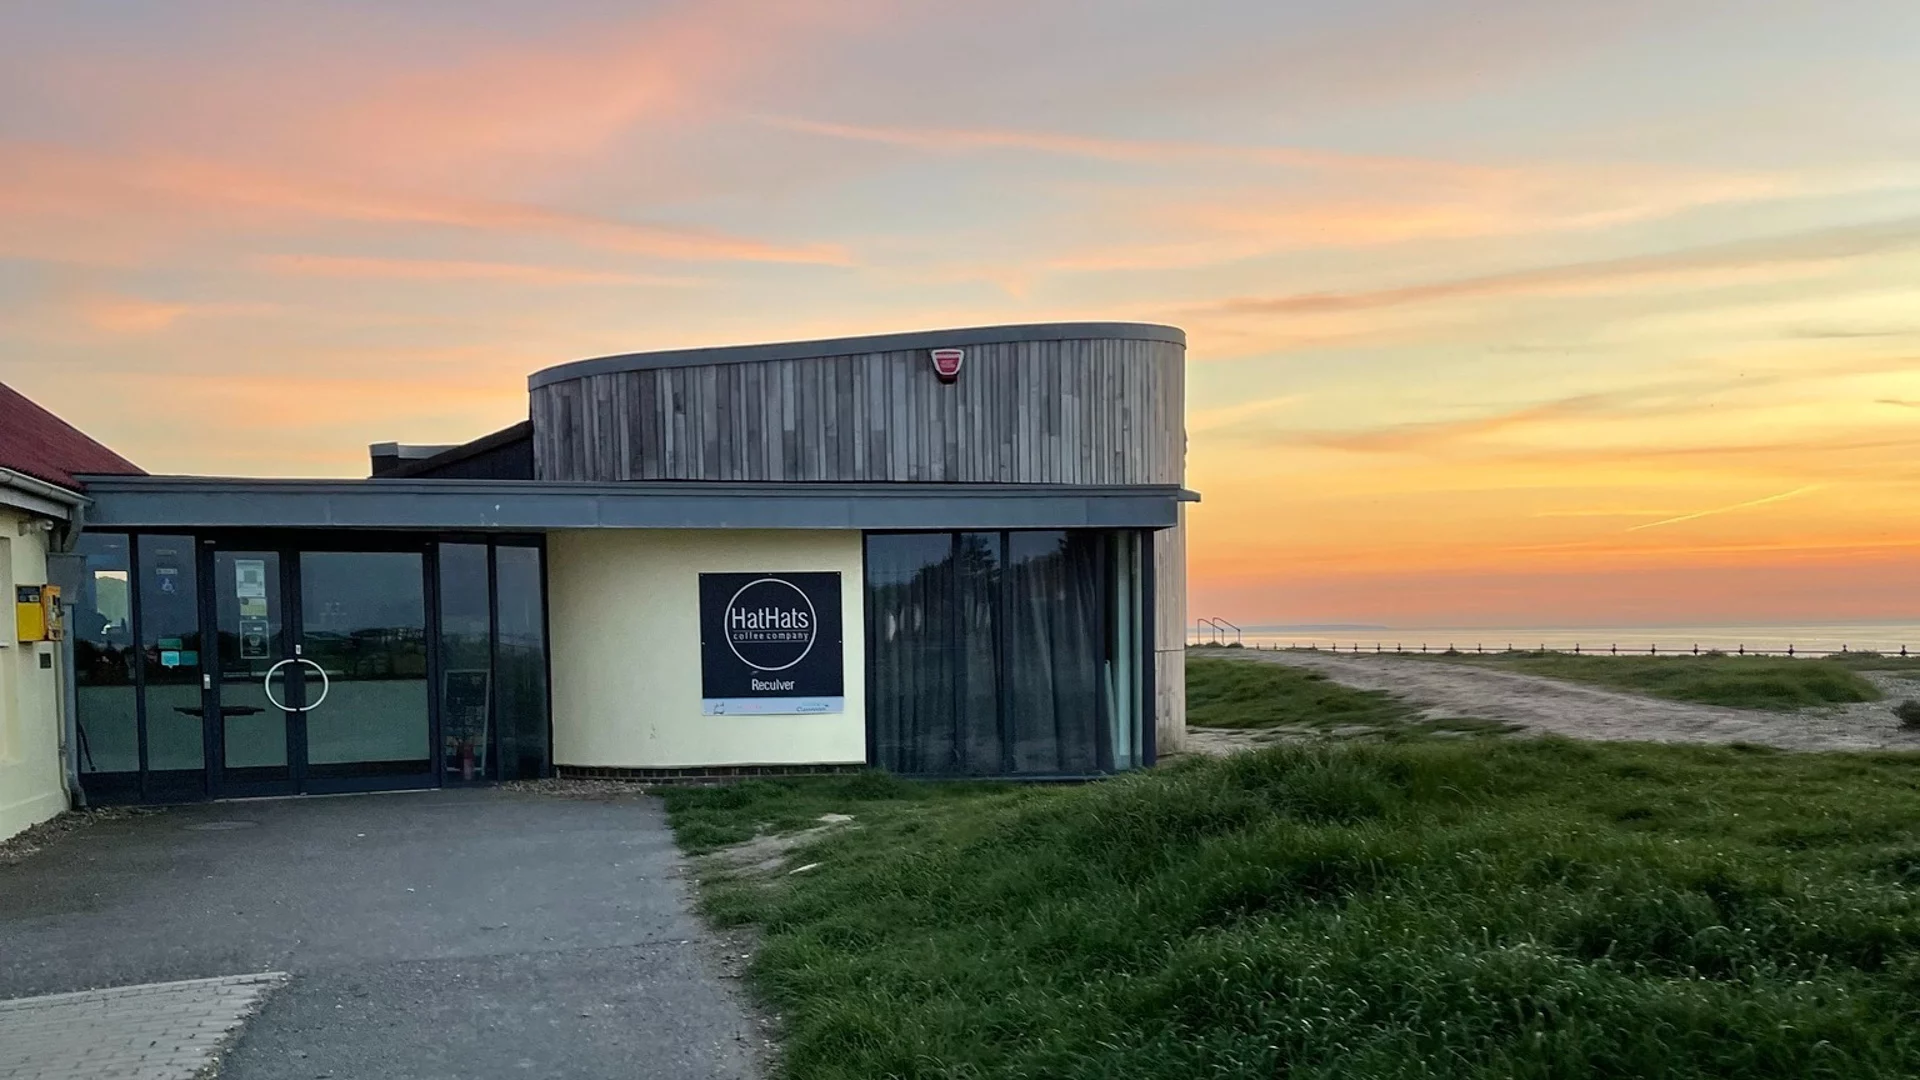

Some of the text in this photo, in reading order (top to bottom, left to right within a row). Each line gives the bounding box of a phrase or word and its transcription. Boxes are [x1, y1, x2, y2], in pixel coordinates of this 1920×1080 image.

[731, 607, 809, 630] HatHats
[733, 631, 809, 642] coffee company
[751, 678, 795, 691] Reculver
